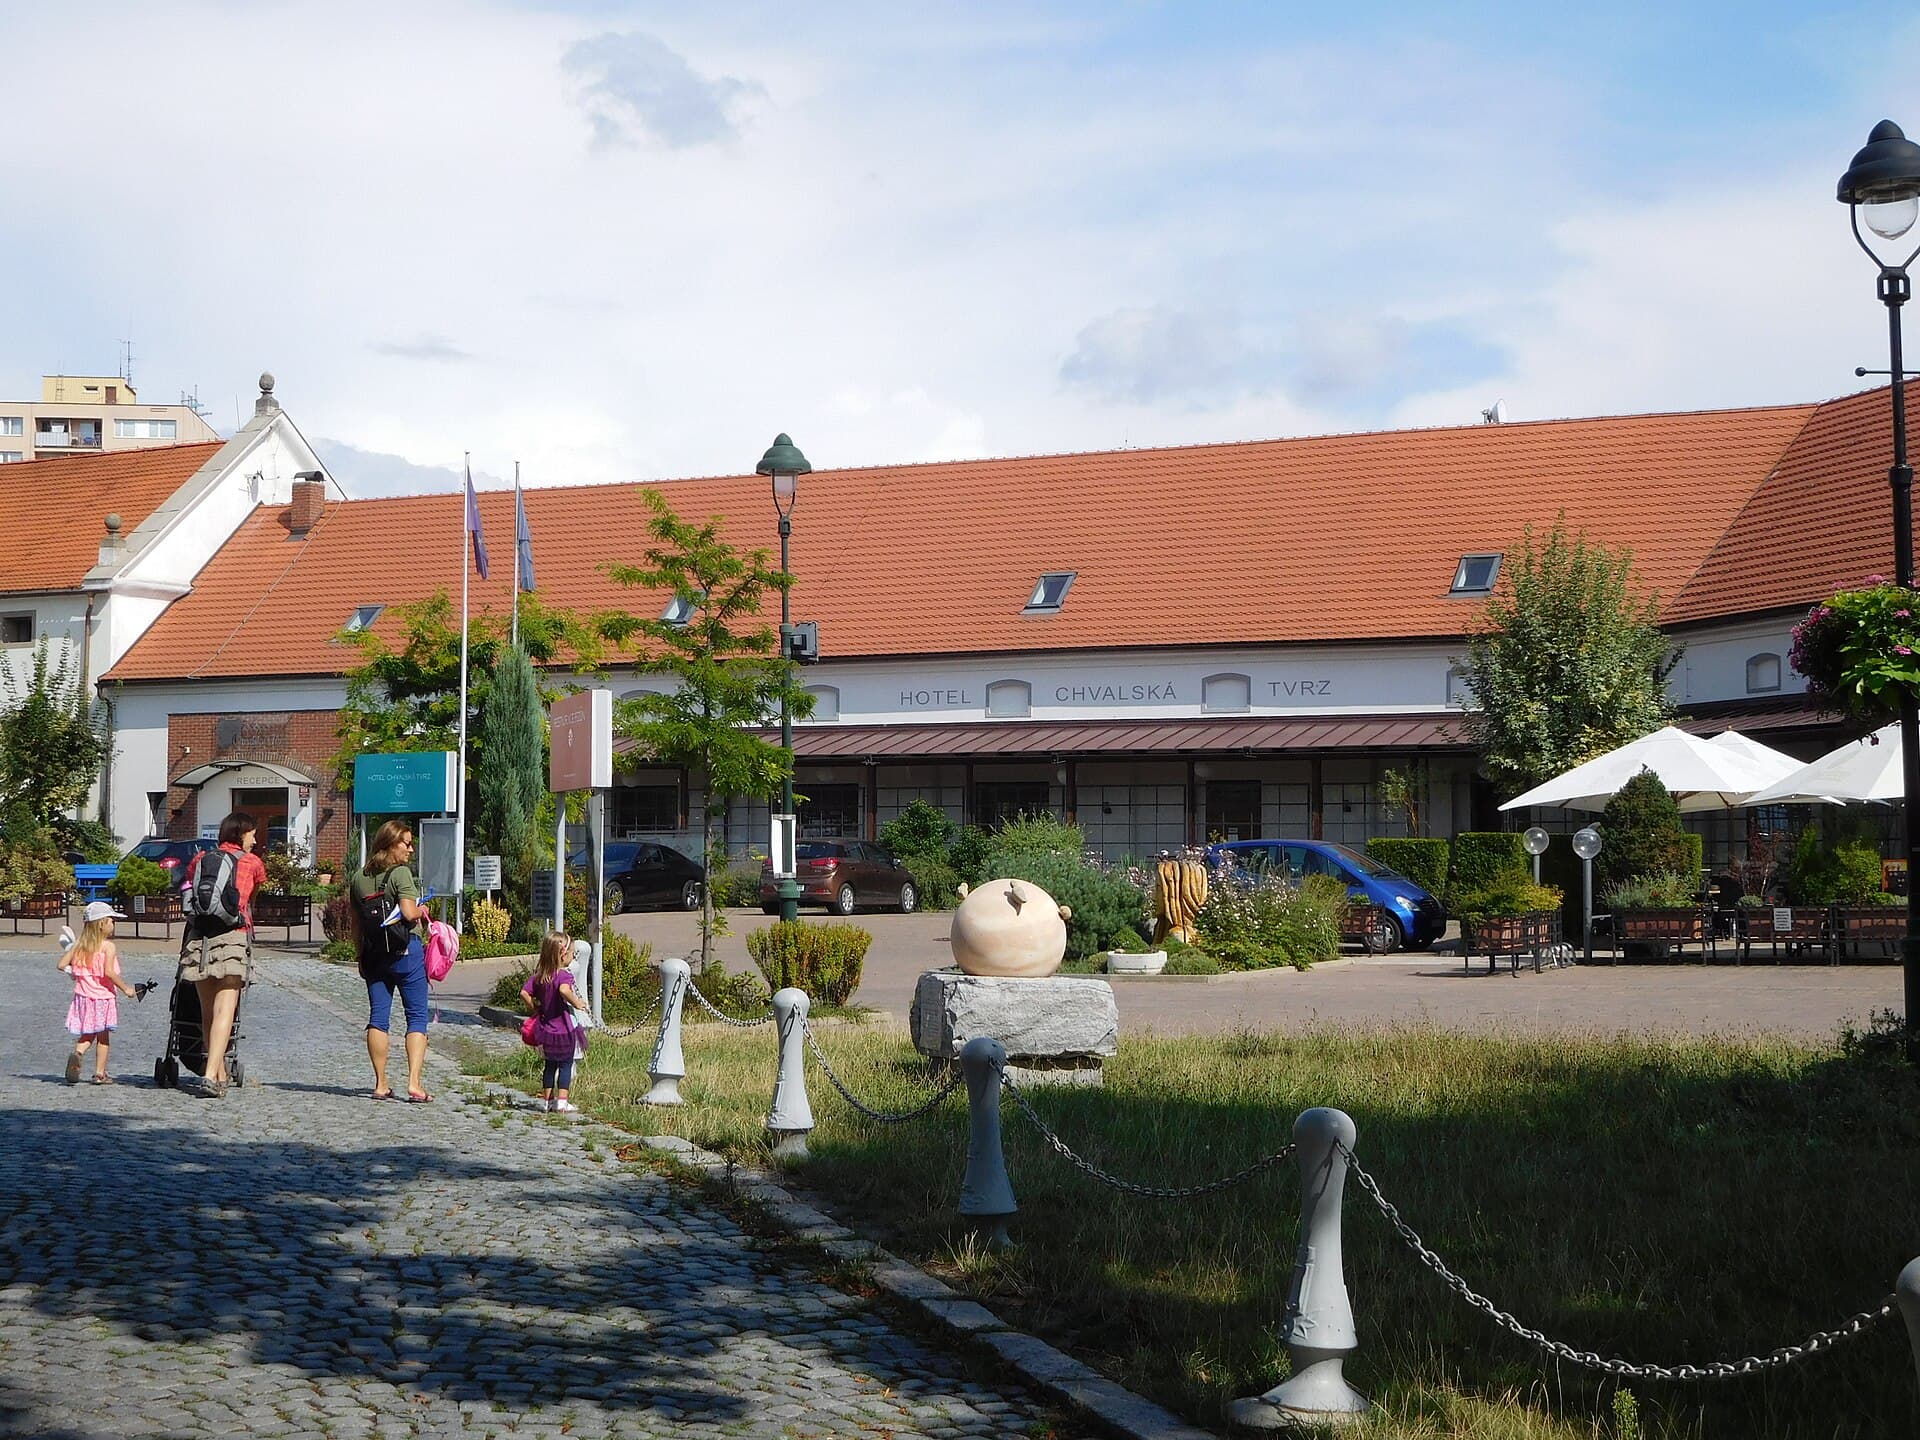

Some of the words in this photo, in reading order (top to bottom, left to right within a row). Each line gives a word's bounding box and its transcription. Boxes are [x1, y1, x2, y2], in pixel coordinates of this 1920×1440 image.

[900, 689, 971, 705] HOTEL
[1056, 681, 1176, 702] CHVALSKÁ
[1268, 680, 1331, 697] TVRZ
[236, 776, 281, 785] RECEPCE
